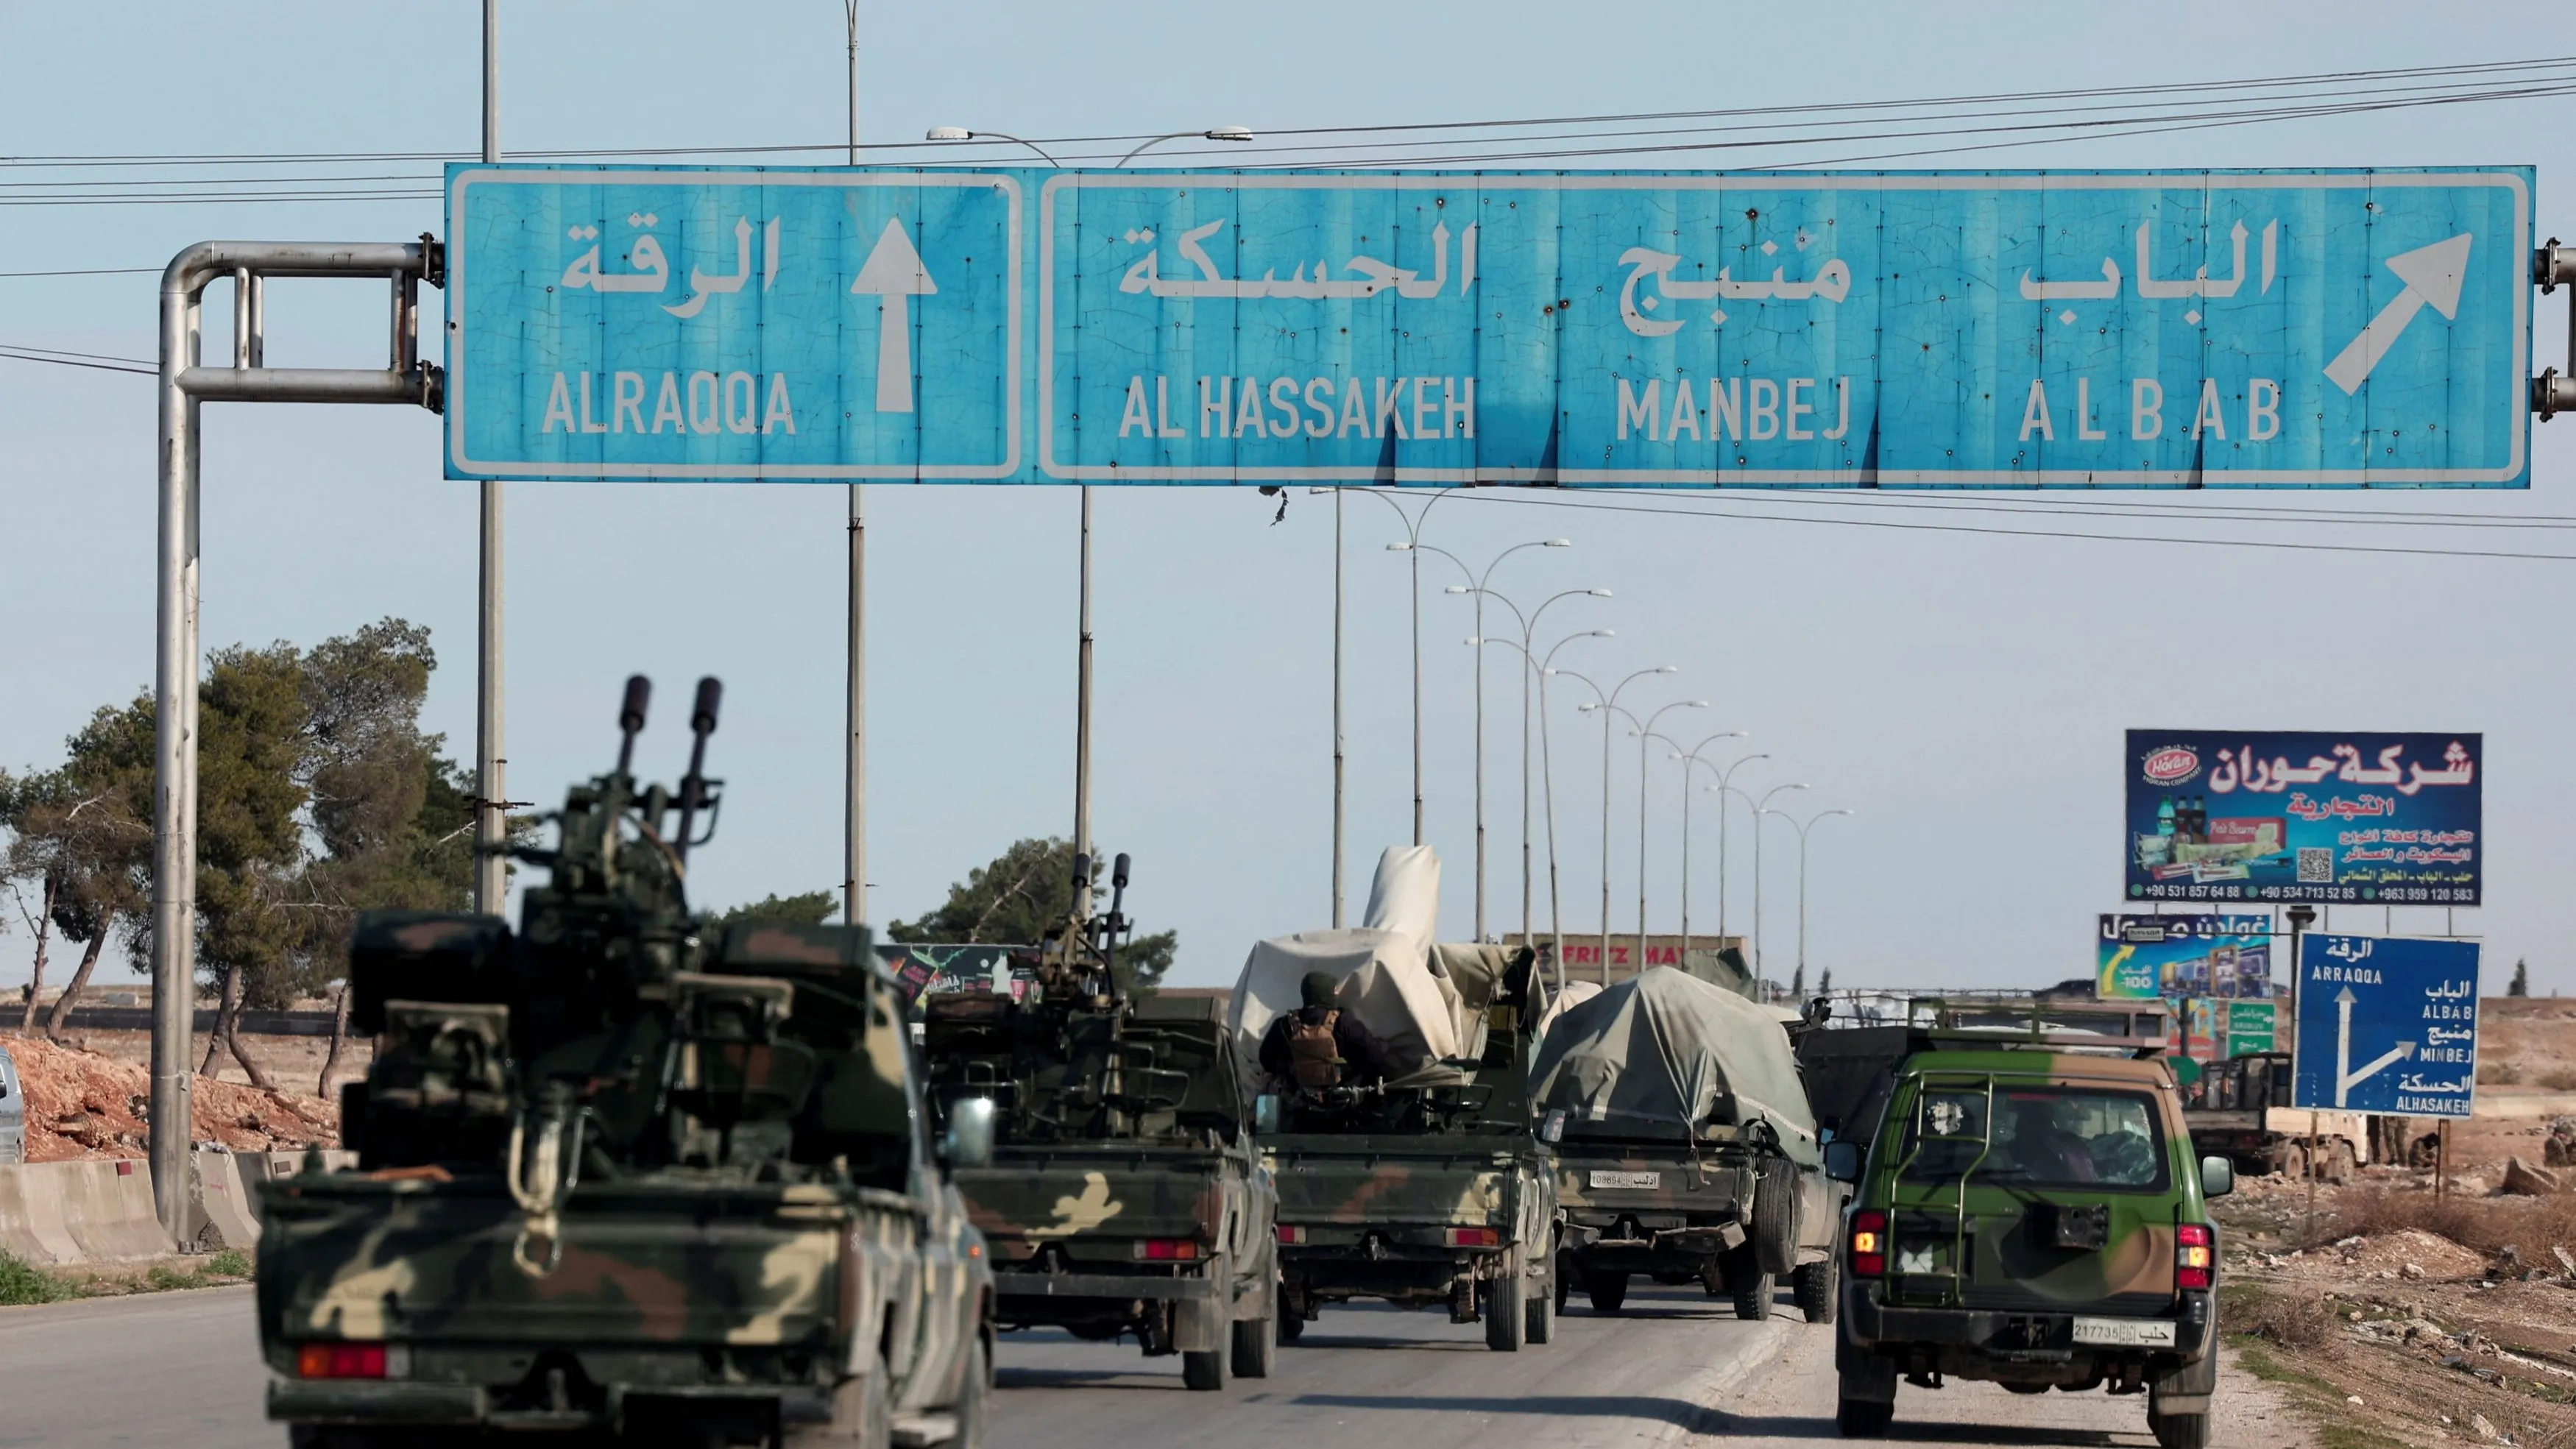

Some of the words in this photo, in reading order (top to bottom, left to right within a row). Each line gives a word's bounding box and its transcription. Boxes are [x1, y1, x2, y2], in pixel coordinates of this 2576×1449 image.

[560, 213, 780, 318] الرقة
[1119, 219, 1476, 297] الحسكة
[2020, 218, 2276, 325] الباب
[1618, 240, 1850, 336] منبج
[542, 372, 795, 434] ALRAQQA
[1200, 376, 1473, 439] HASSAKEH
[1618, 378, 1850, 441] MANBEJ
[2209, 745, 2338, 793] حوران
[2332, 741, 2473, 796] شركة
[2287, 793, 2394, 820] التجارية
[2145, 885, 2165, 897] +90
[2168, 885, 2185, 897] 531
[2189, 885, 2207, 897] 857
[2210, 885, 2223, 898] 64
[2260, 886, 2279, 899] +90
[2283, 886, 2301, 899] 534
[2305, 886, 2324, 899] 713
[2327, 887, 2339, 899] 52
[2378, 888, 2404, 899] +963
[1563, 946, 1629, 965] FRIZ
[2326, 938, 2373, 963] الرقة
[2312, 966, 2382, 985] ARRAQQA
[2425, 979, 2471, 1003] الباب
[2427, 1024, 2472, 1046] منبج
[2420, 1047, 2473, 1063] MINBEJ
[2398, 1073, 2471, 1093] الحسكة
[2396, 1096, 2469, 1113] ALHASAKEH
[2139, 1325, 2169, 1343] حلب
